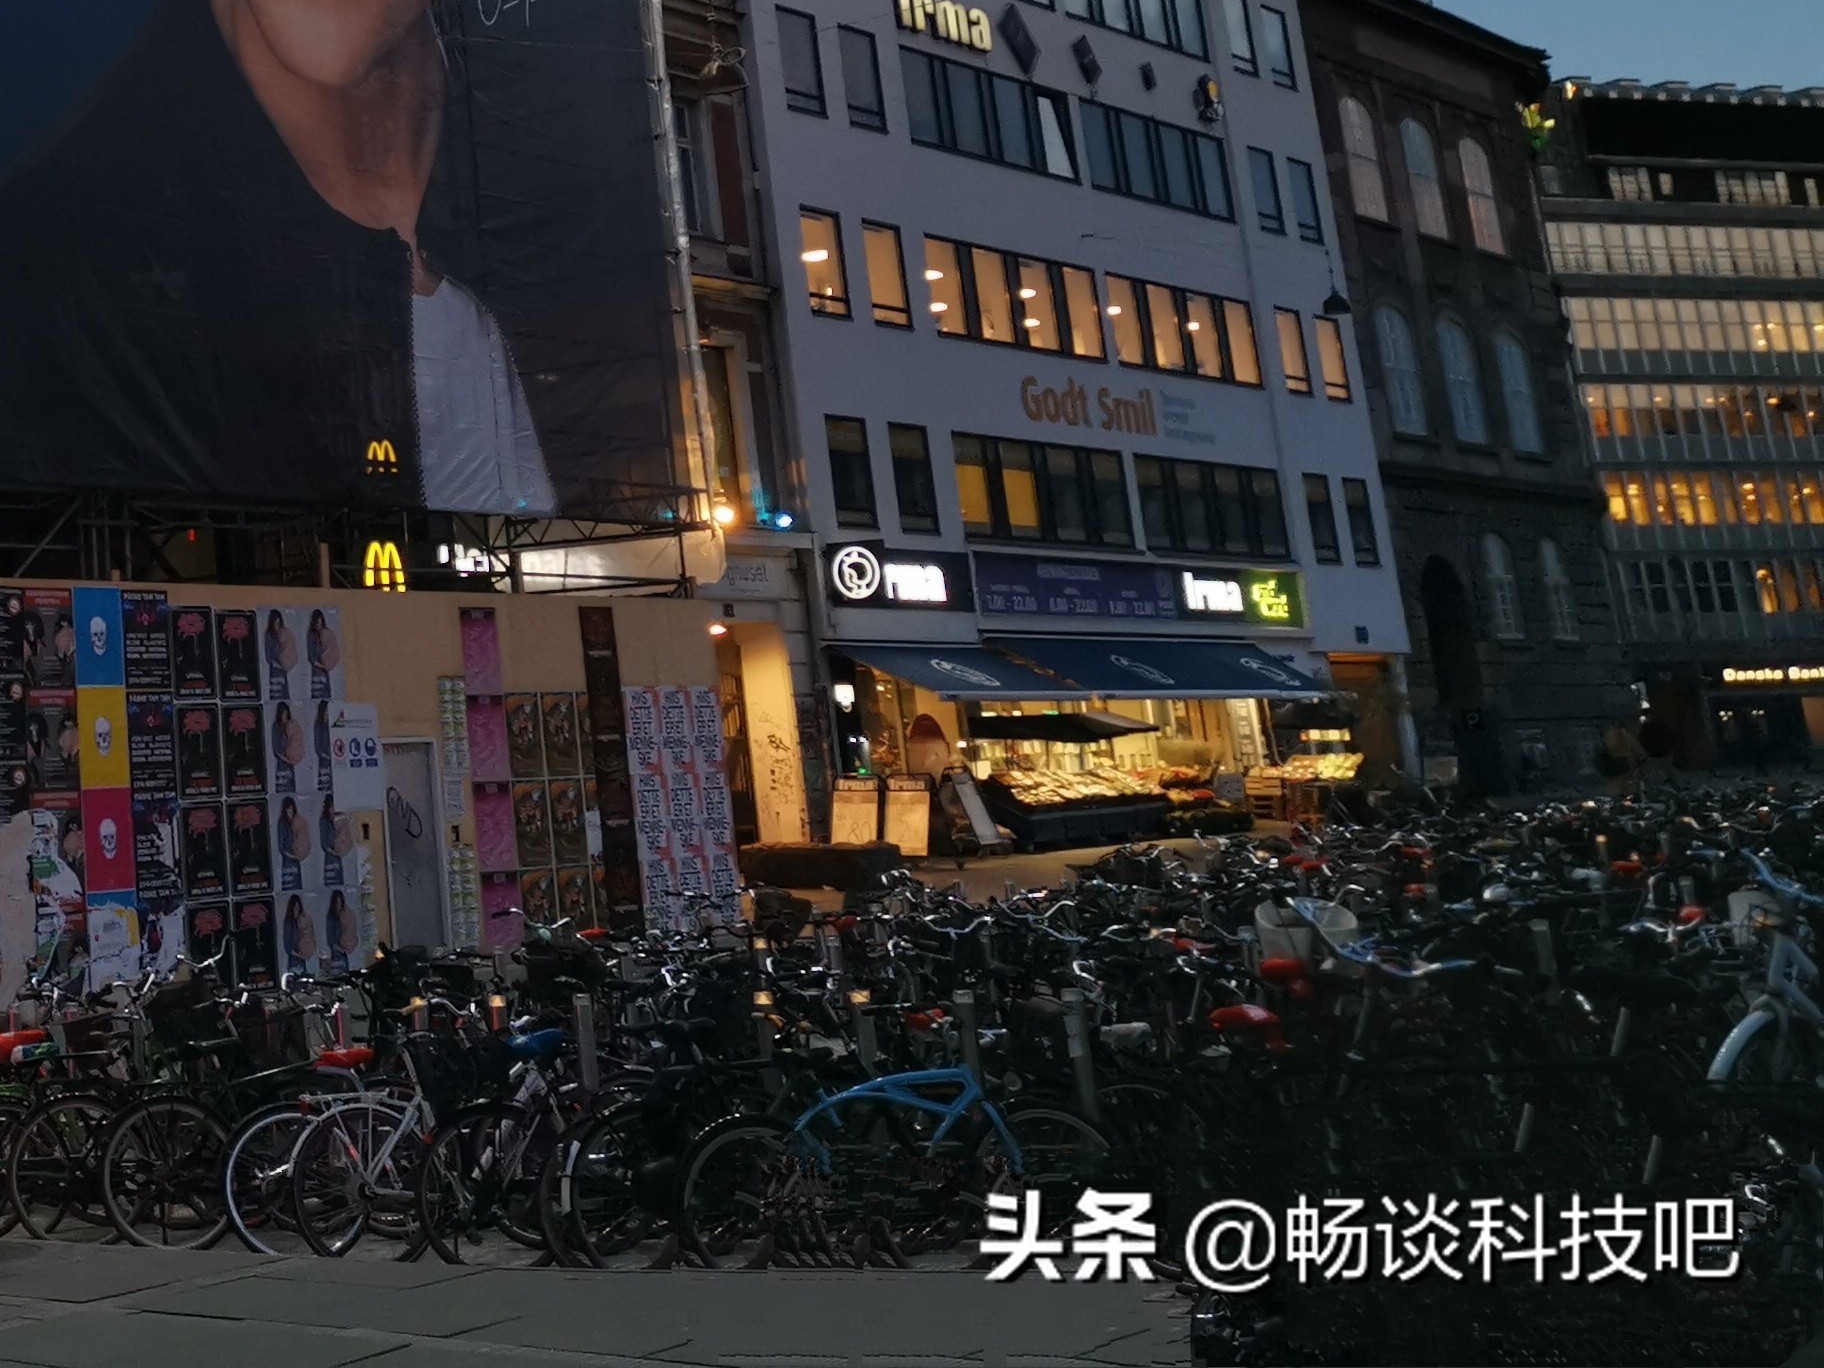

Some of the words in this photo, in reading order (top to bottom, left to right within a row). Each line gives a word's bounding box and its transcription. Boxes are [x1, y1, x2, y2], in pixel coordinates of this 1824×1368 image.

[1020, 375, 1094, 428] Godt
[1096, 386, 1158, 436] Smil
[1181, 571, 1244, 613] Irma
